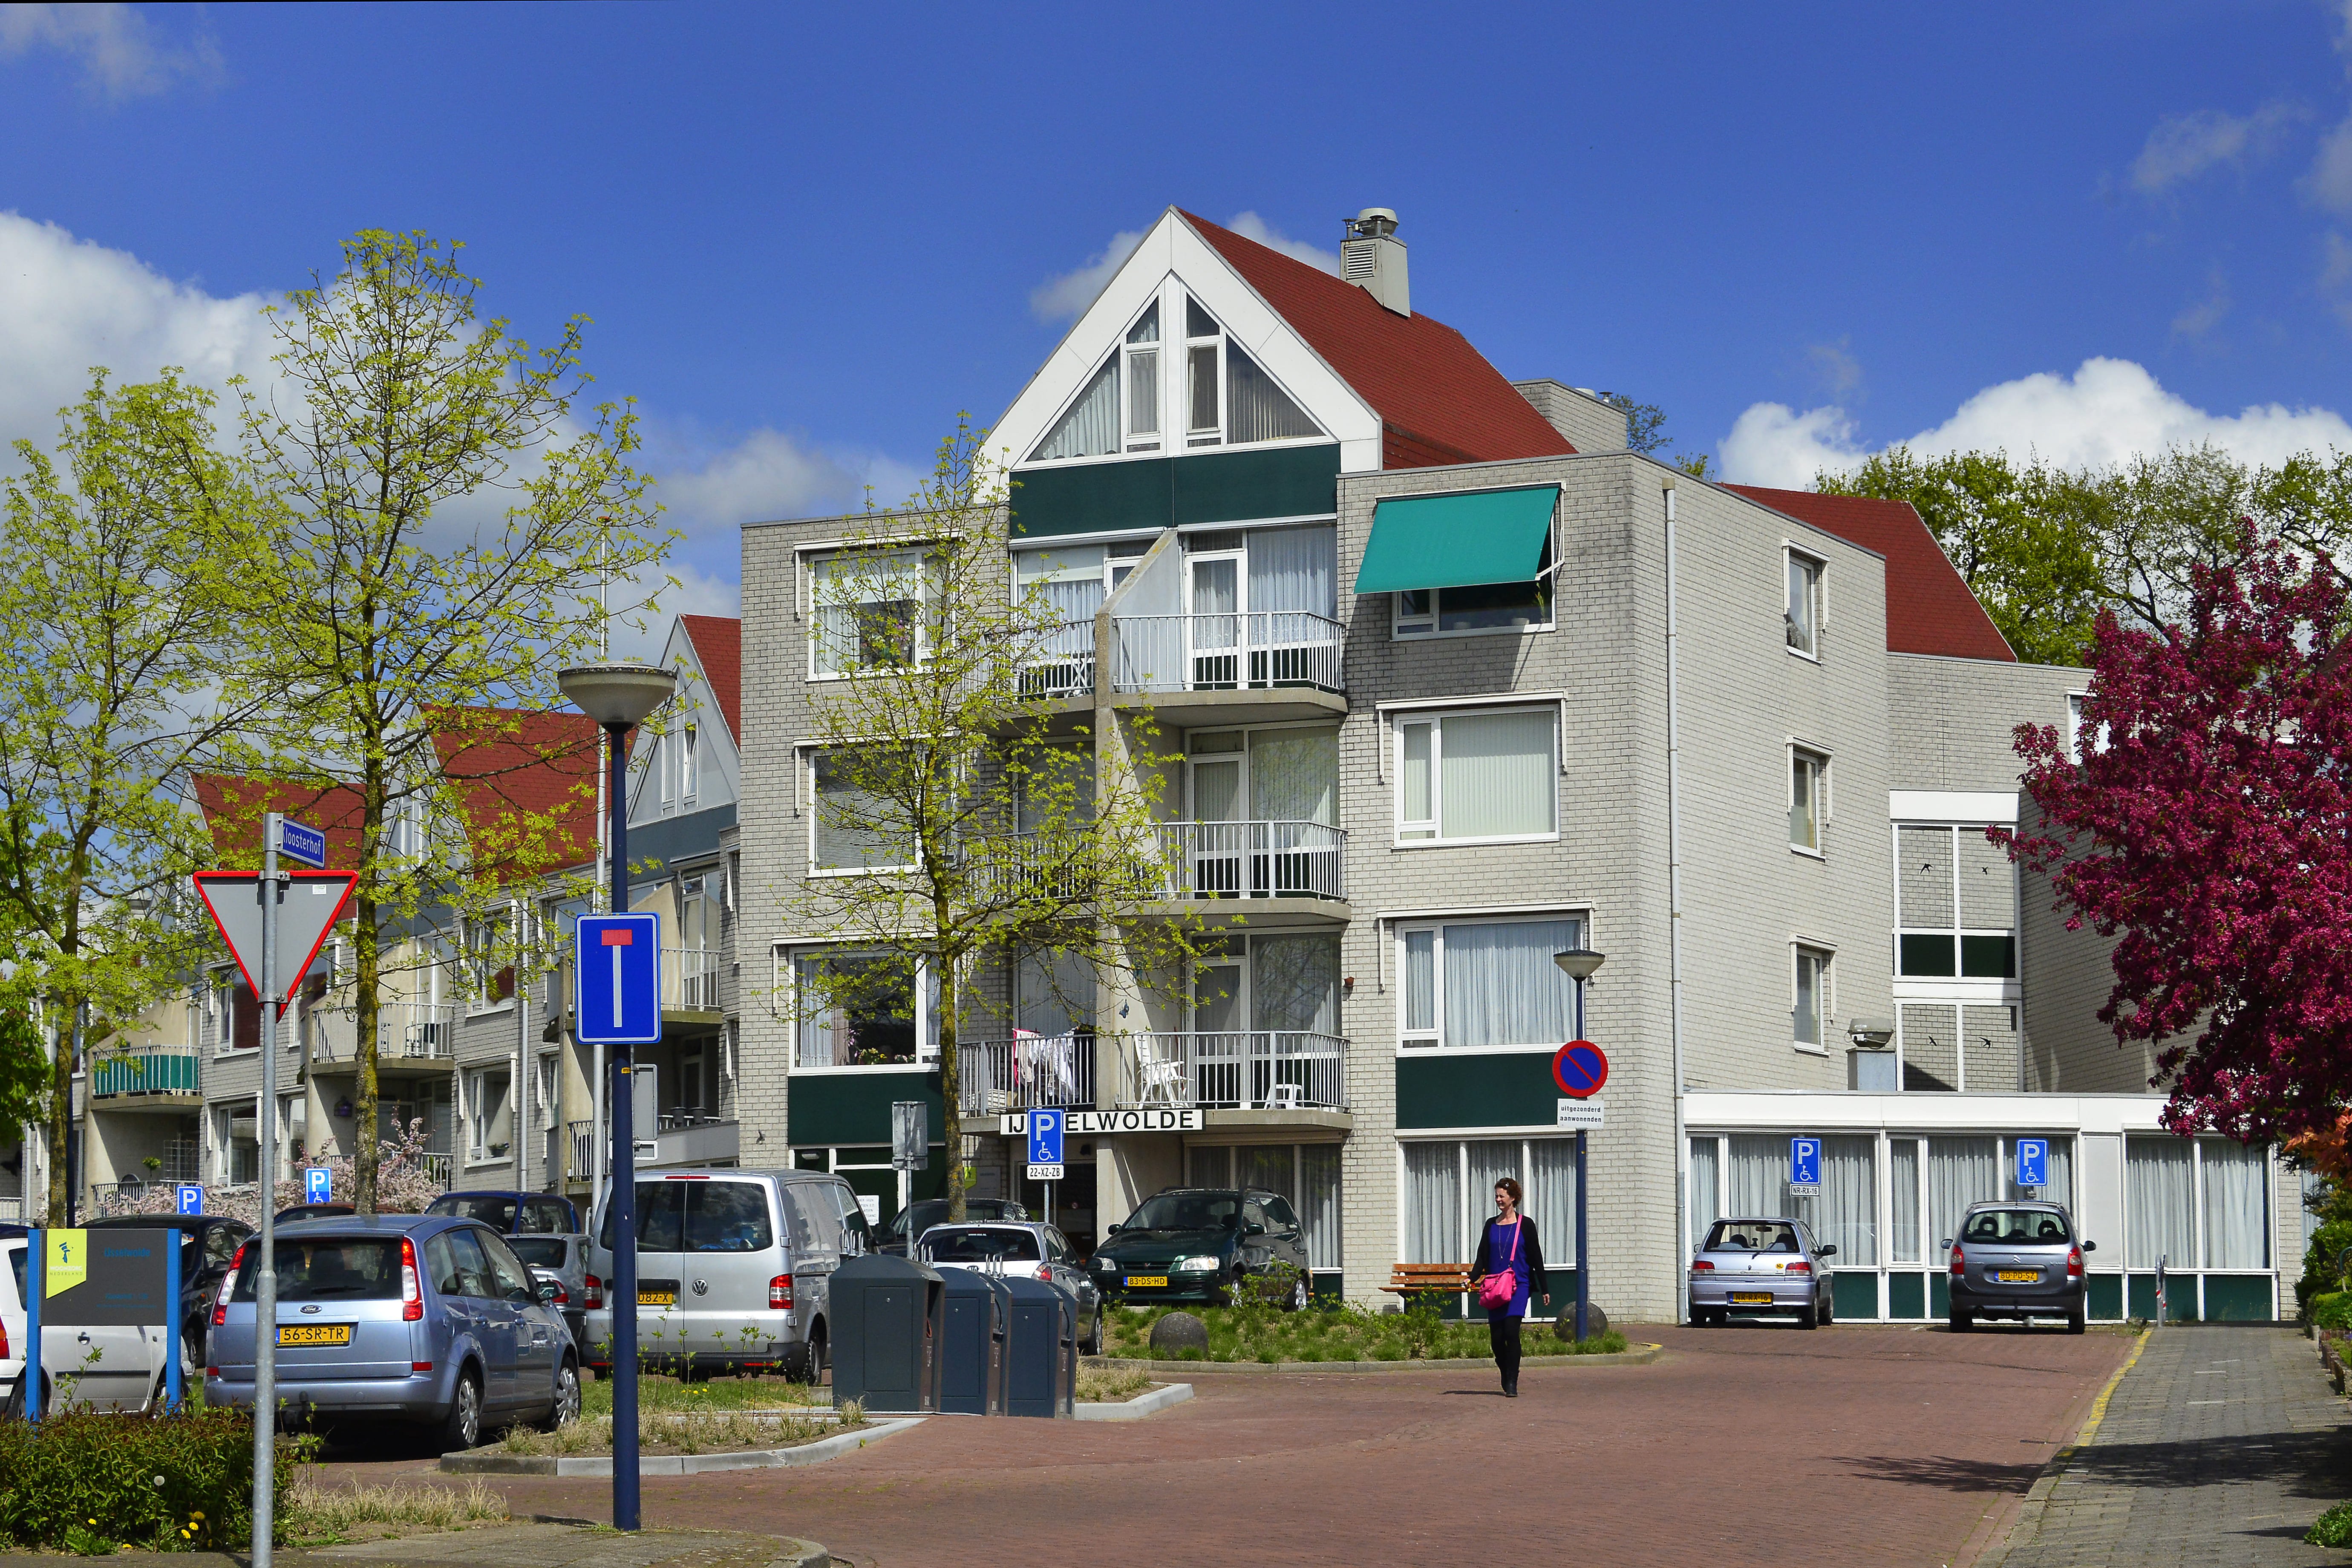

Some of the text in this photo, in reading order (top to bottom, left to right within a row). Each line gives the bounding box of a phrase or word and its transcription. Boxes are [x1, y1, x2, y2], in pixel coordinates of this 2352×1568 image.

[1008, 1110, 1194, 1133] IJELWOLDE
[1036, 1114, 1055, 1141] P
[1798, 1142, 1814, 1164] P
[2023, 1144, 2040, 1166] P
[312, 1172, 326, 1192] P
[1029, 1167, 1061, 1177] 22-XZ-ZB
[183, 1190, 197, 1210] P
[638, 1293, 669, 1303] 082-X
[1735, 1292, 1768, 1301] NR-RX-16
[283, 1327, 344, 1340] 56-SR-TR
